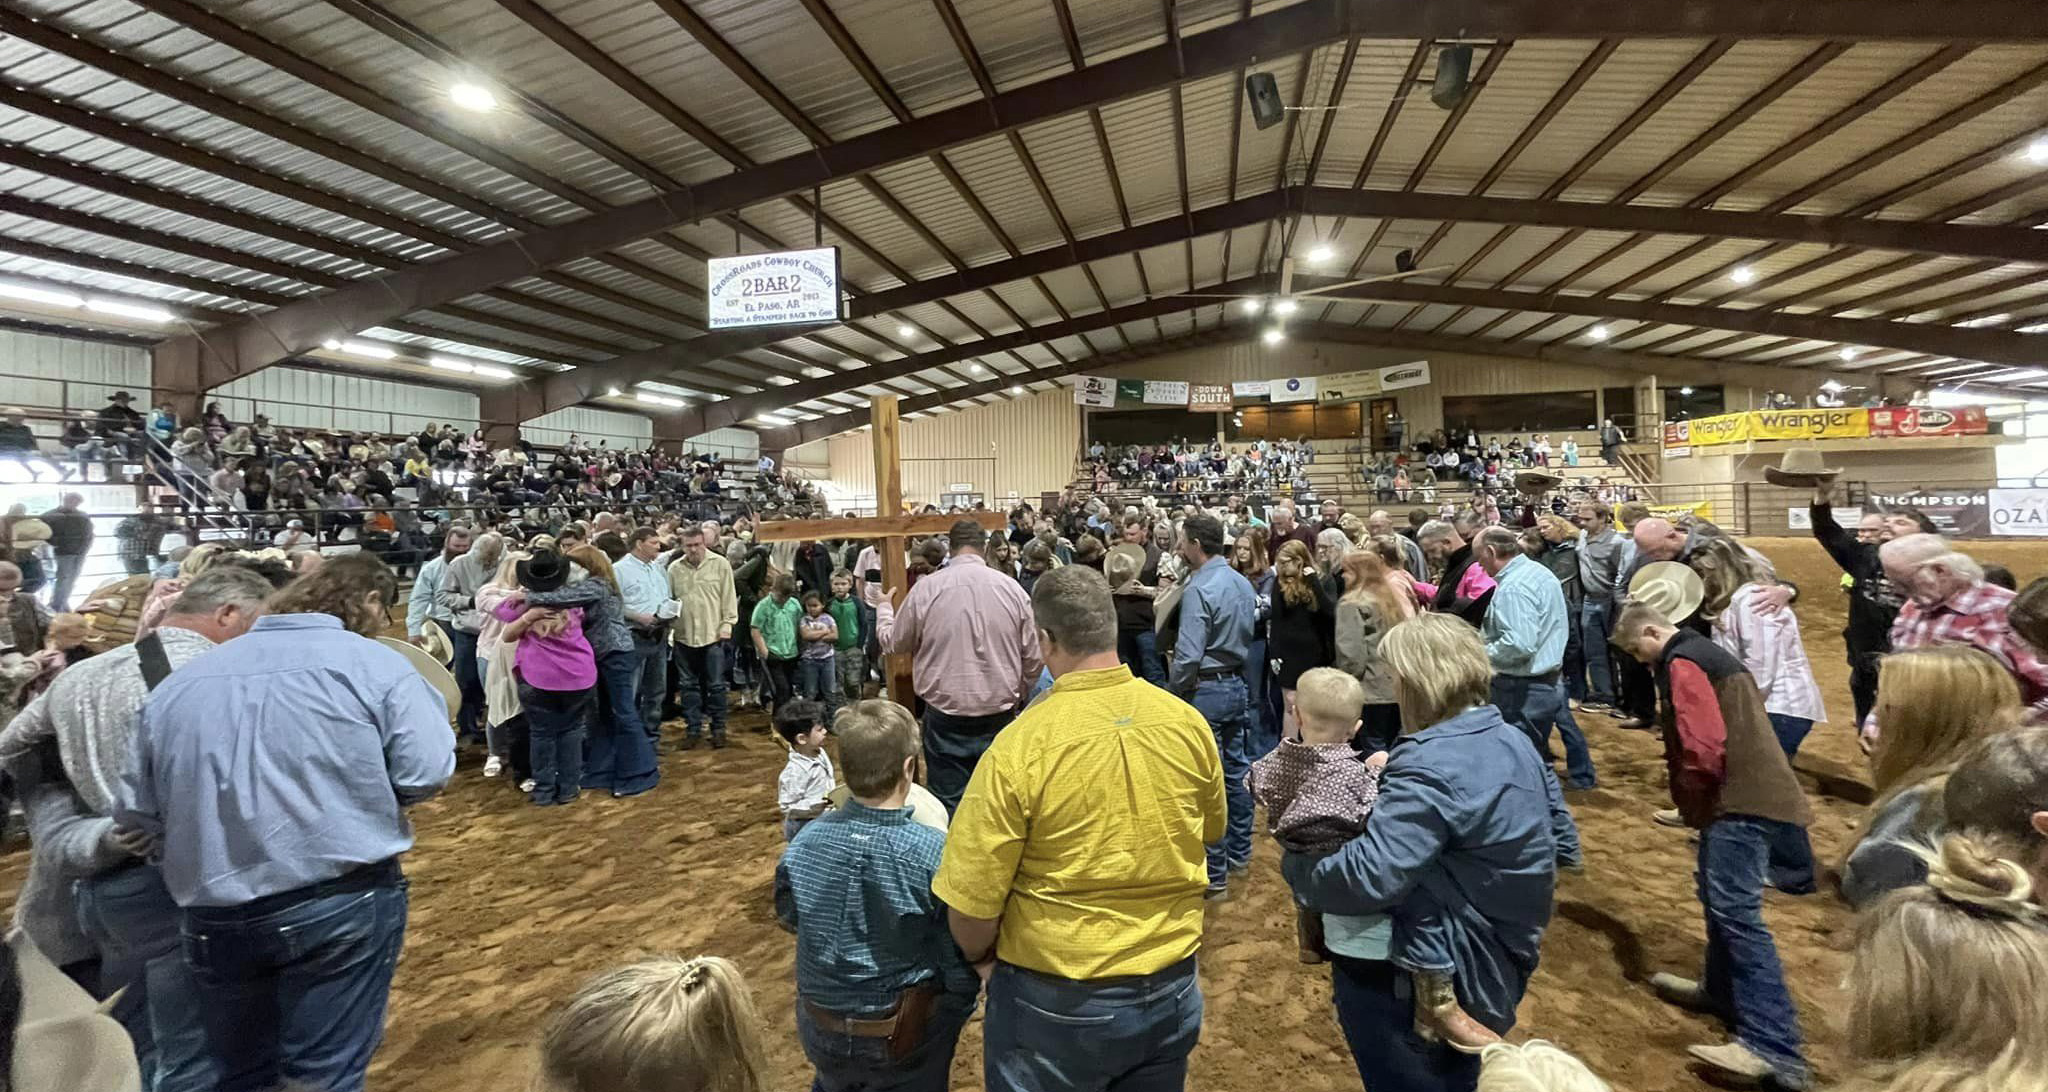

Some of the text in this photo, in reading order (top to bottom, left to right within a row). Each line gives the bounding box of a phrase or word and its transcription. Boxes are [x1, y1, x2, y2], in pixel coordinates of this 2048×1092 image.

[764, 256, 801, 267] COWBOY
[803, 260, 833, 288] CHURCH
[744, 303, 756, 312] EL
[786, 299, 800, 309] AR
[1191, 393, 1231, 403] SOUTH
[1693, 417, 1739, 440] Wrangler
[1759, 409, 1852, 434] Wrangler
[1871, 495, 1987, 506] THOMPSON
[1993, 507, 2048, 526] OZA
